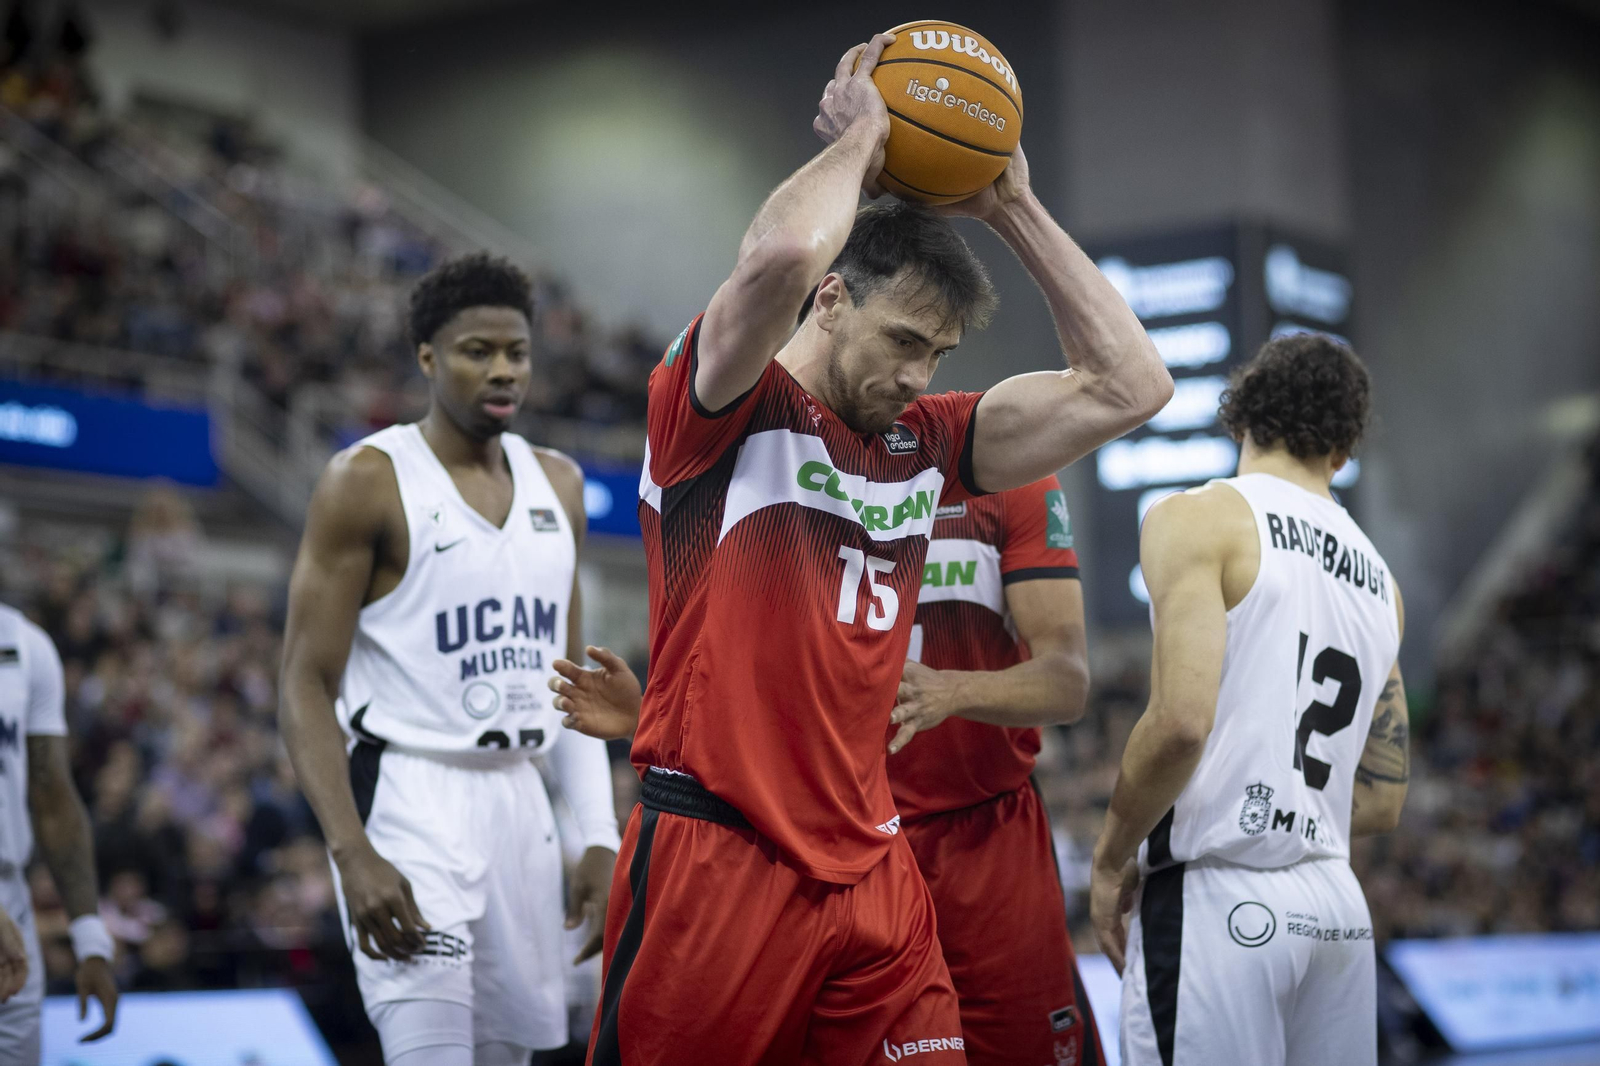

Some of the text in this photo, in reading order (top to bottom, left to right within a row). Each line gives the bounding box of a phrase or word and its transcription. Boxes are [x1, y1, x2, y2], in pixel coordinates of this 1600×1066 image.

[909, 30, 1018, 95] Wilson
[905, 79, 1007, 133] liga endesa
[890, 439, 917, 450] endesa
[836, 544, 899, 632] 15
[435, 595, 557, 655] UCAM
[1293, 630, 1362, 791] 12
